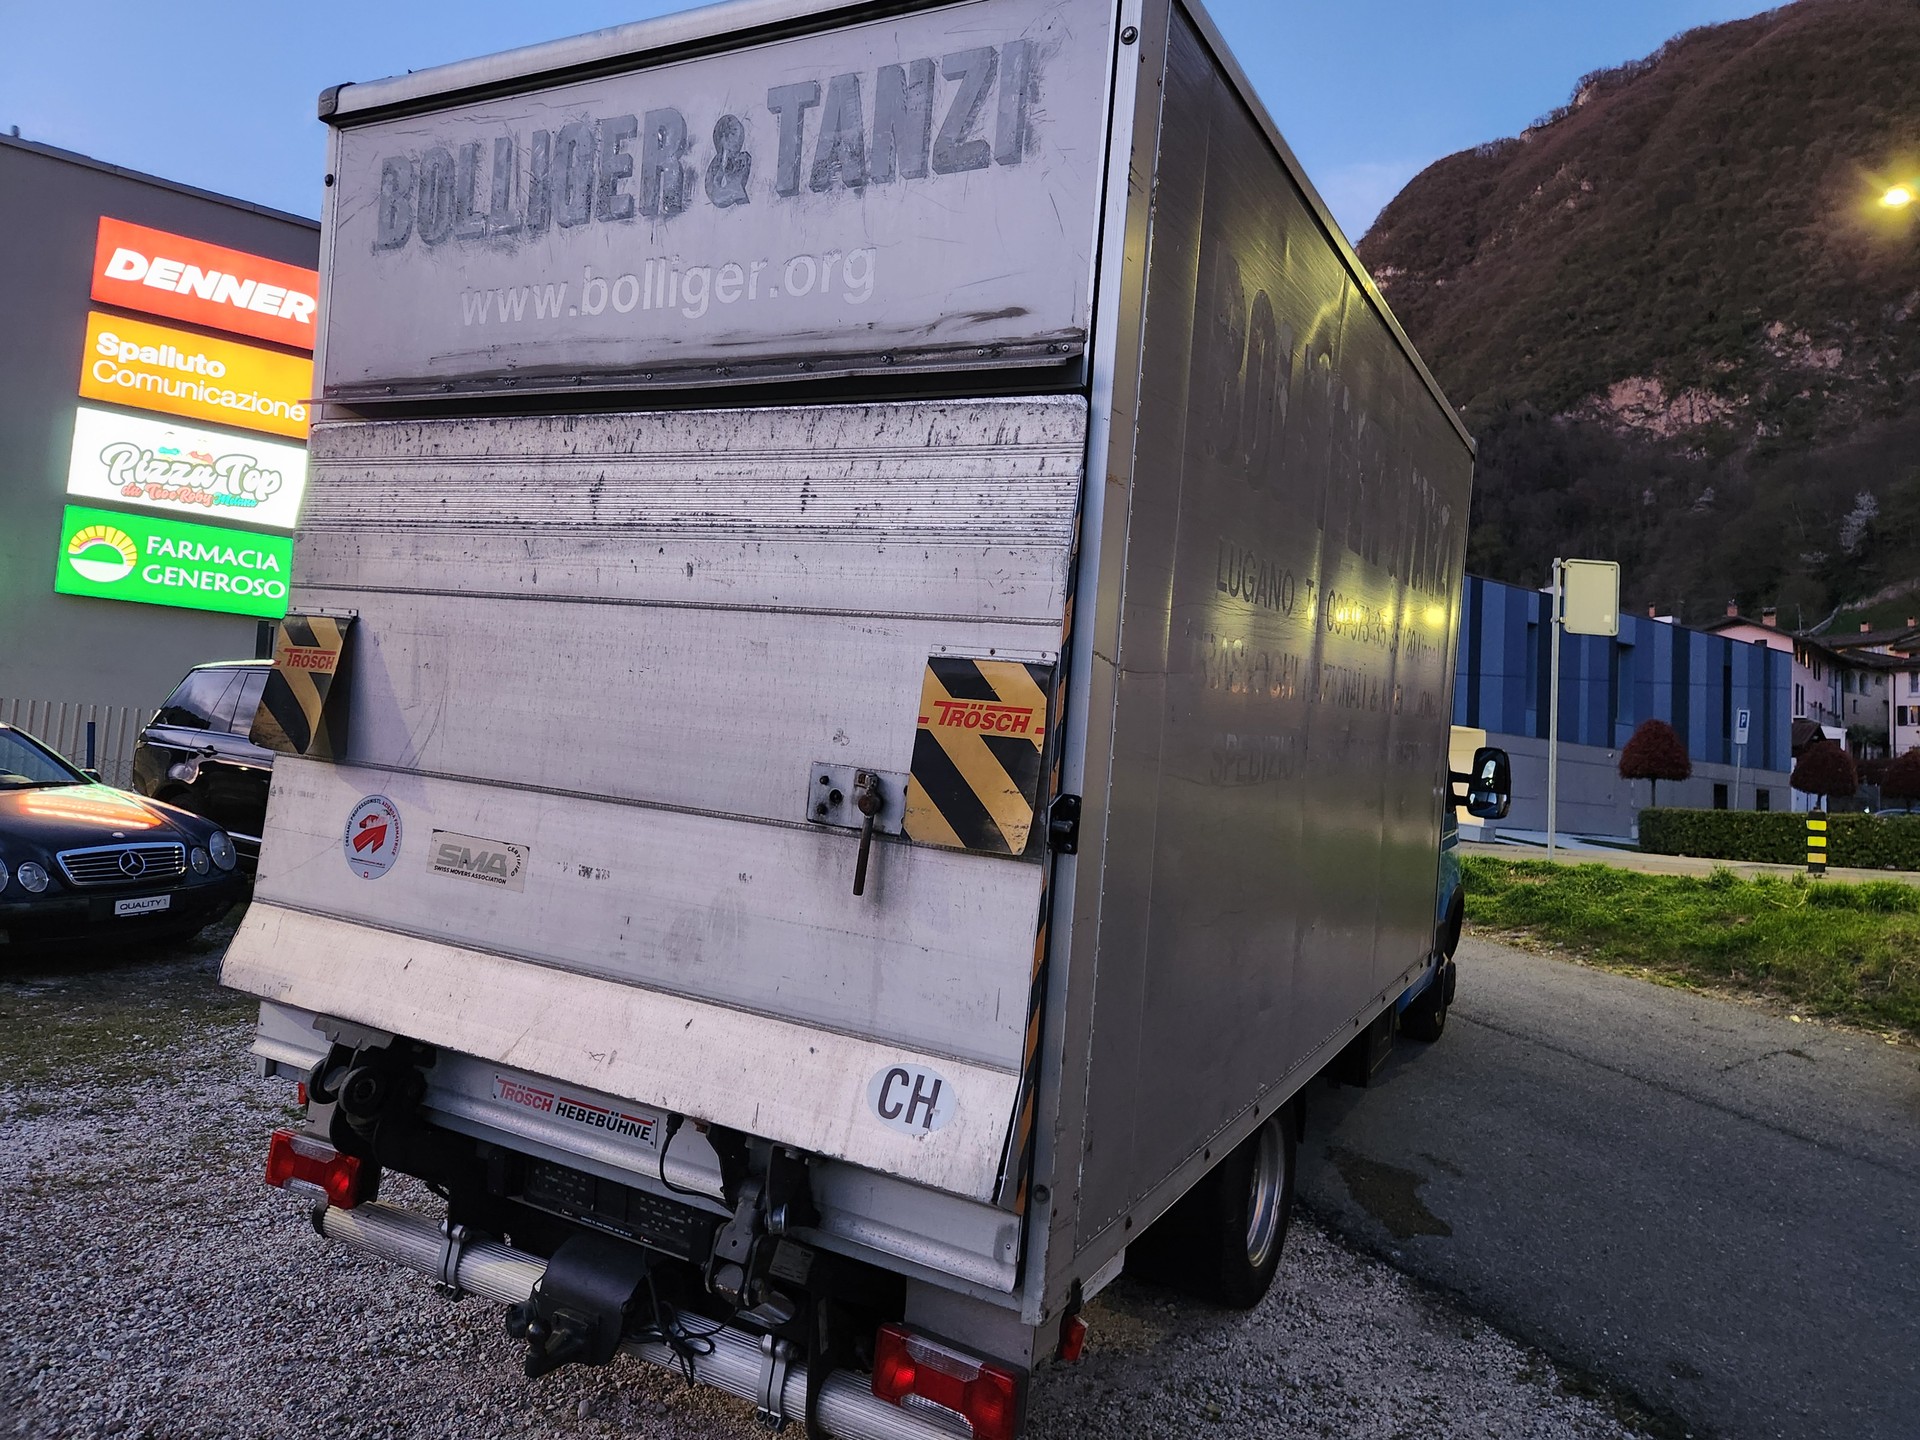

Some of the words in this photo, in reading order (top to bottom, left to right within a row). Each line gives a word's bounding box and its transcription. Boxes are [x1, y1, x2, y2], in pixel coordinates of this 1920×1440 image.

[374, 107, 690, 251] BOLLIGER
[705, 114, 751, 208] &
[768, 39, 1033, 197] TANZI
[104, 247, 316, 324] DENNER
[460, 246, 877, 326] www.bolliger.org
[96, 331, 226, 378] Spalluto
[92, 359, 306, 422] Comunicazione
[100, 441, 217, 489] Pizza
[213, 453, 282, 501] Top
[146, 535, 280, 572] FARMACIA
[1216, 537, 1294, 617] LUGANO
[142, 564, 286, 598] GENEROSO
[284, 647, 337, 670] TRÖSCH
[933, 700, 1033, 734] TRÖSCH
[433, 864, 451, 874] SWISS
[449, 869, 472, 878] MOVERS
[471, 873, 507, 885] ASSOCIATION
[436, 843, 507, 877] SMA
[120, 898, 162, 910] QUALITY
[497, 1078, 554, 1112] TRÖSCH
[555, 1102, 652, 1141] HEBEBÜHNE
[877, 1067, 943, 1130] CH
